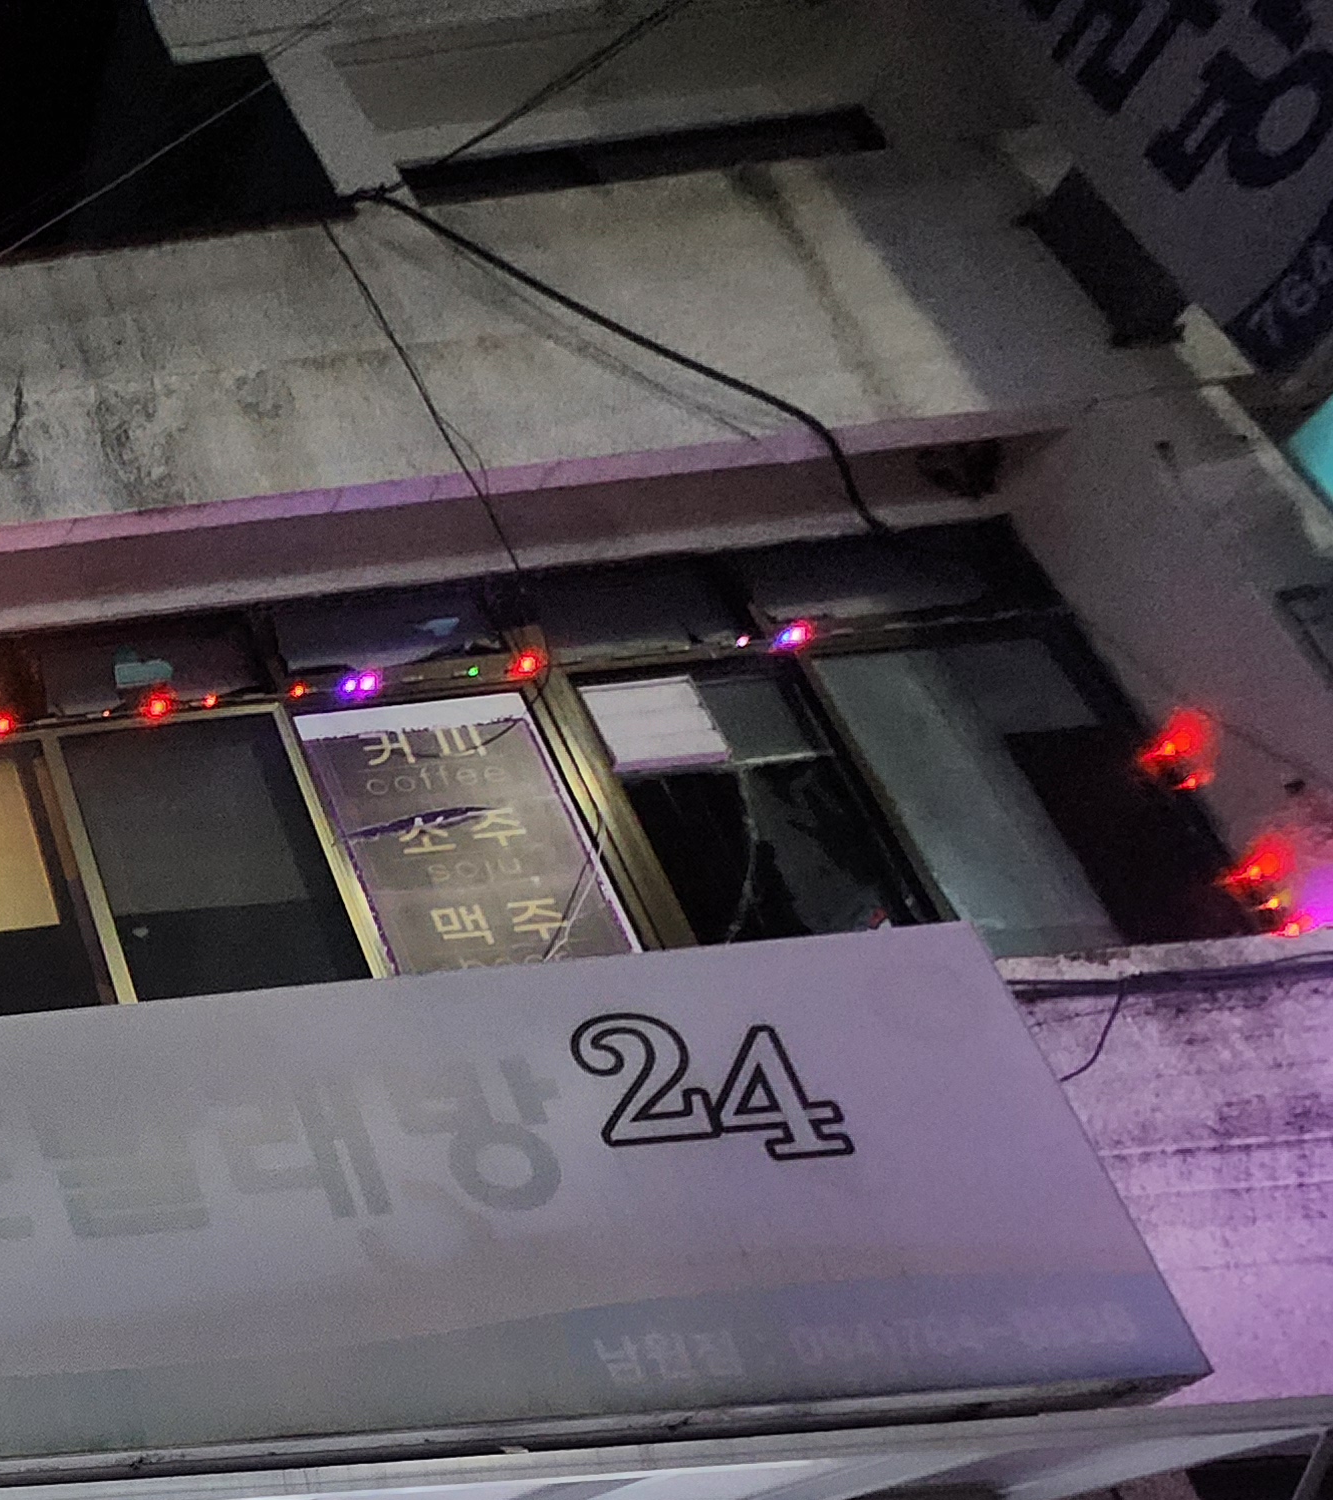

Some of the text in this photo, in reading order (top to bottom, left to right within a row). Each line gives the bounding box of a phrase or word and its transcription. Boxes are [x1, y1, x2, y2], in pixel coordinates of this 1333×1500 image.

[360, 723, 489, 766] 커피
[366, 761, 508, 797] coffee
[399, 807, 527, 856] 소주
[431, 898, 571, 946] 맥주
[571, 1013, 854, 1161] 24
